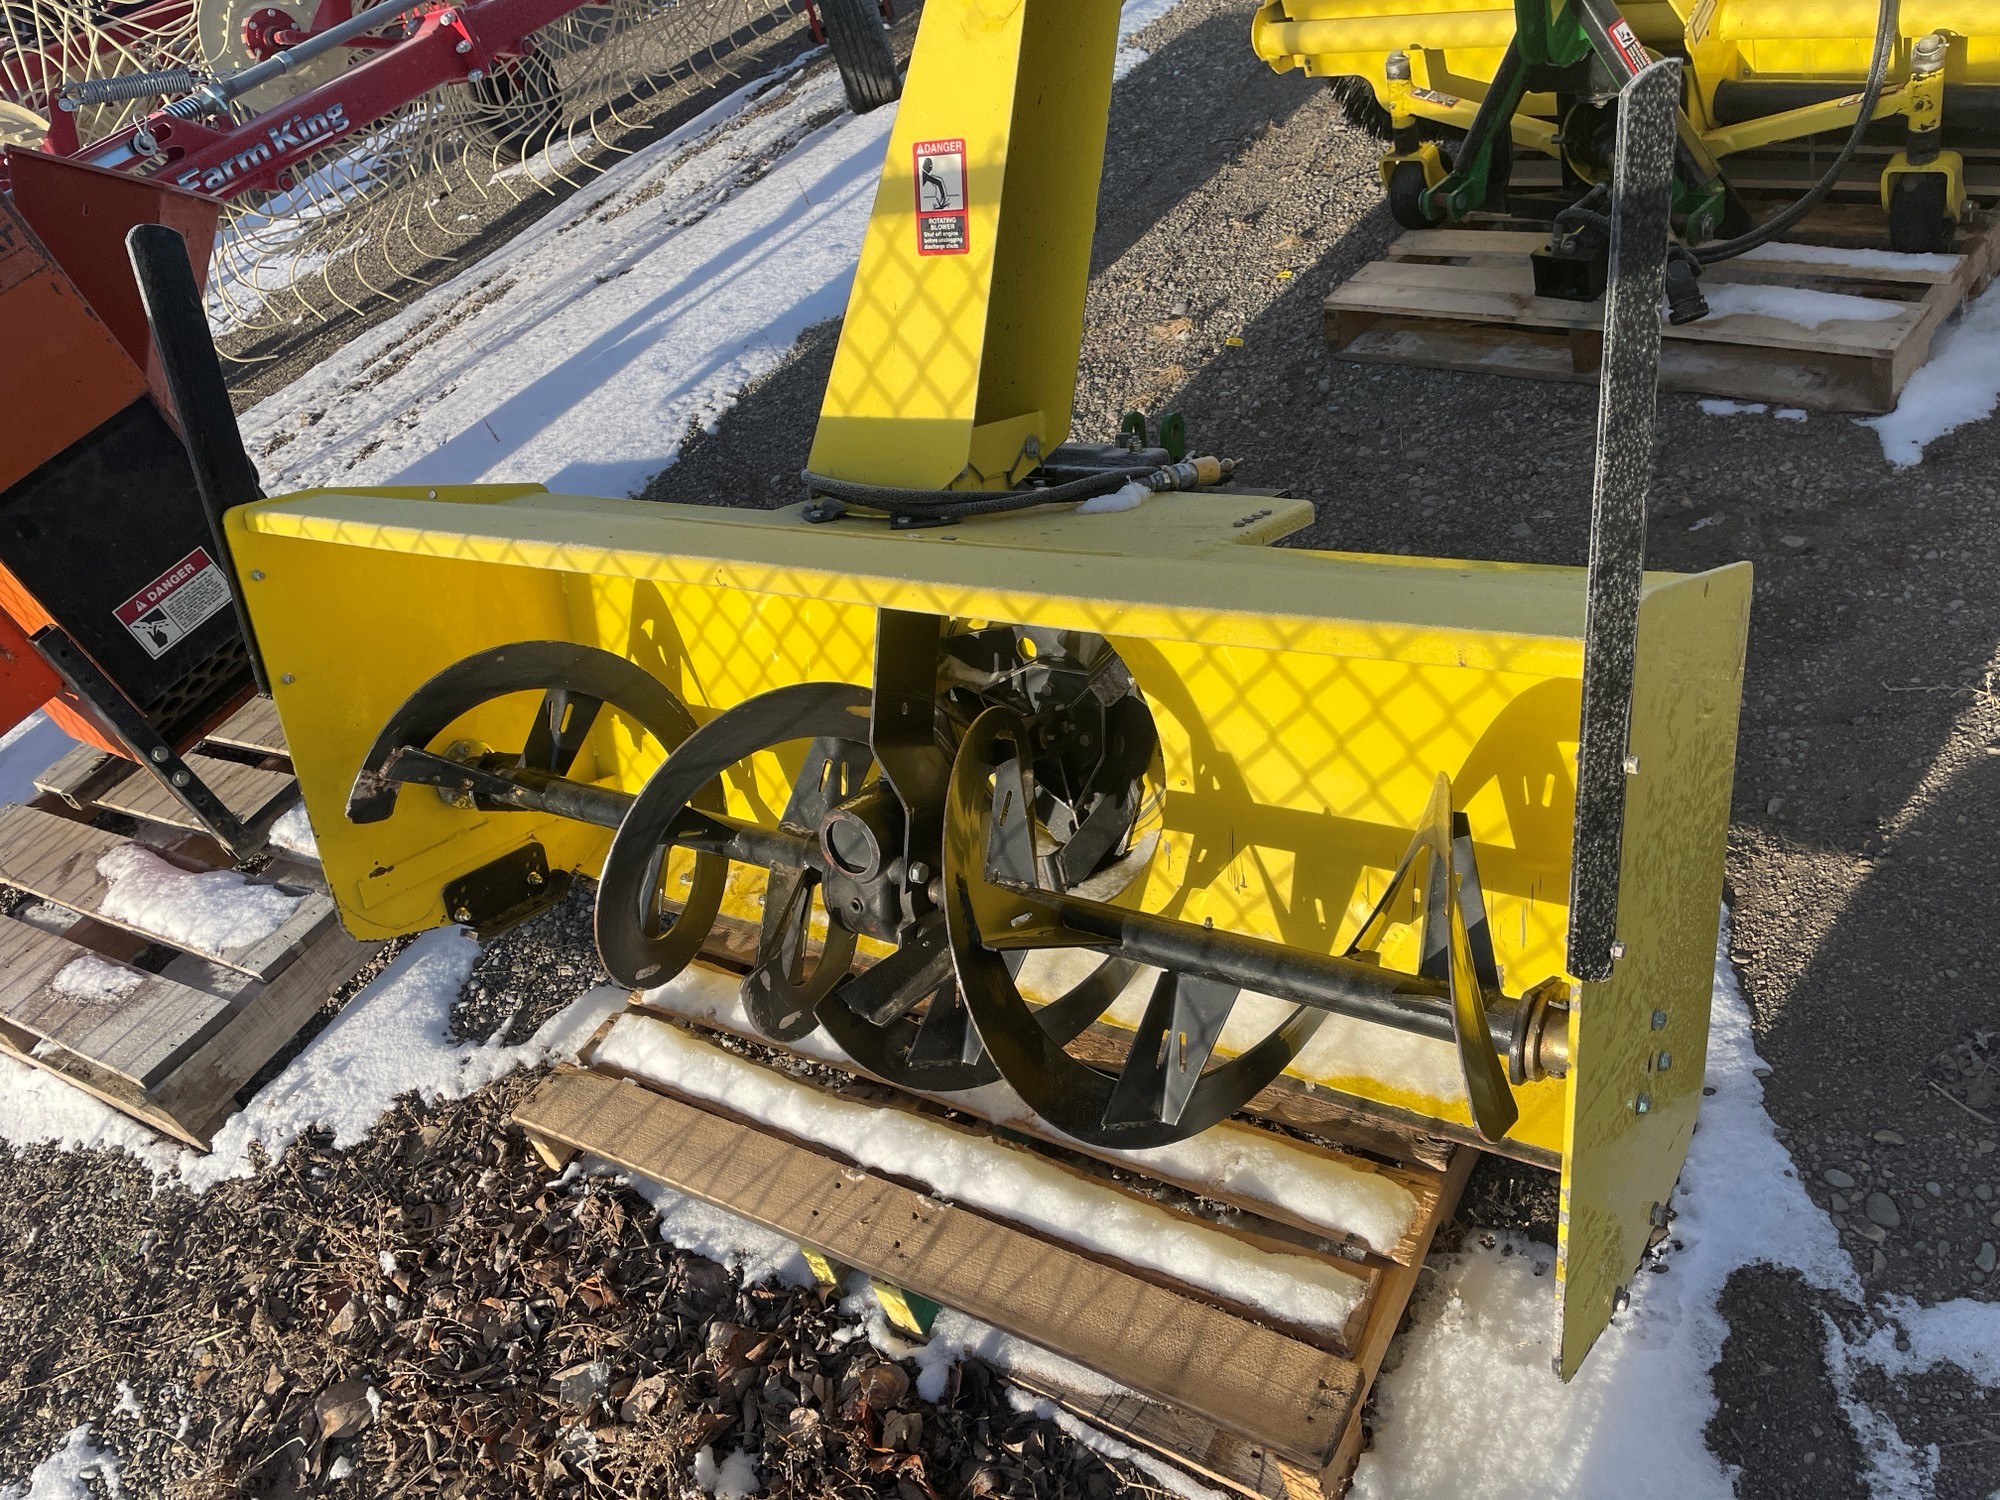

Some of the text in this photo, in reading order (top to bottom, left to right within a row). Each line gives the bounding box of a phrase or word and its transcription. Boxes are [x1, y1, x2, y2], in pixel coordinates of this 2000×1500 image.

[176, 102, 350, 190] Farm King
[923, 141, 962, 154] DANGER
[147, 563, 195, 602] DANGER
